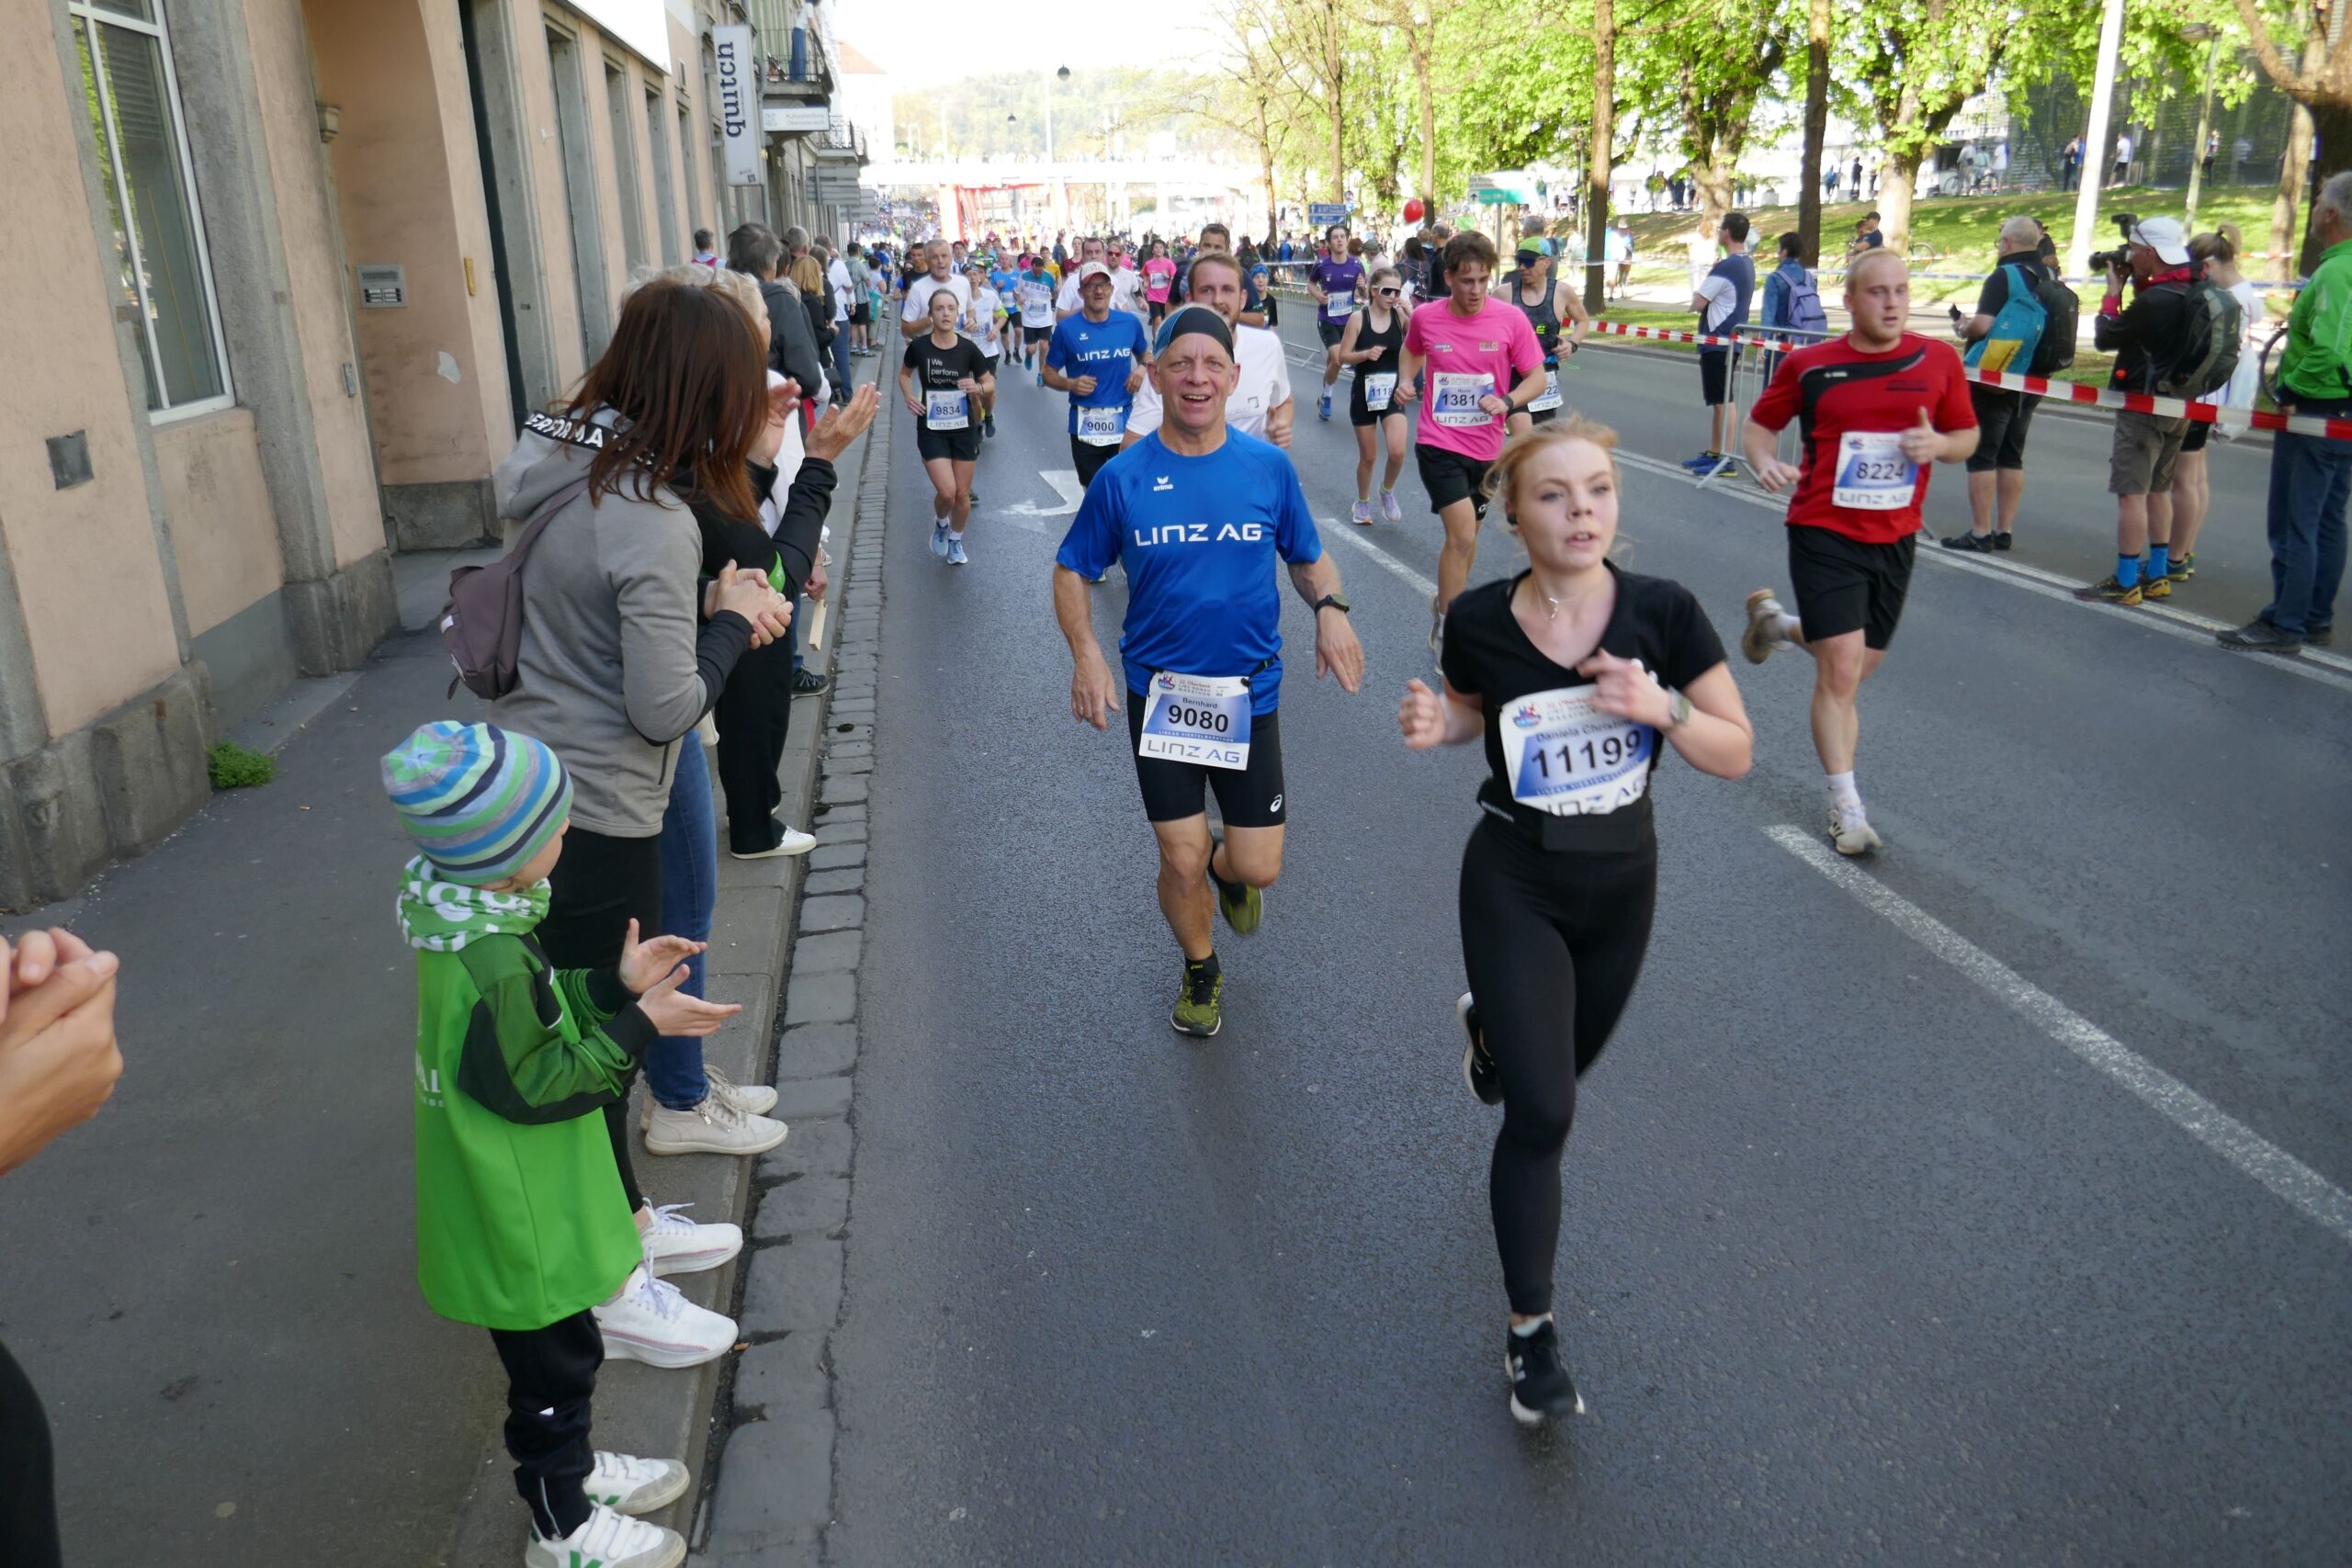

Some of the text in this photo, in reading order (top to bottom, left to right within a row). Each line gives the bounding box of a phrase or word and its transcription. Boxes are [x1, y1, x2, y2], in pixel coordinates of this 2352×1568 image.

[718, 41, 745, 138] quitch
[1114, 348, 1131, 358] AG
[932, 358, 943, 367] We
[931, 368, 959, 378] perform
[935, 405, 961, 415] 9834
[1470, 415, 1488, 424] AG
[1087, 421, 1114, 432] 9000
[1856, 462, 1905, 479] 8224
[1216, 523, 1262, 542] AG
[1182, 697, 1217, 709] Bernhard
[1168, 705, 1228, 733] 9080
[1205, 749, 1240, 764] AG
[1532, 729, 1641, 778] 11199
